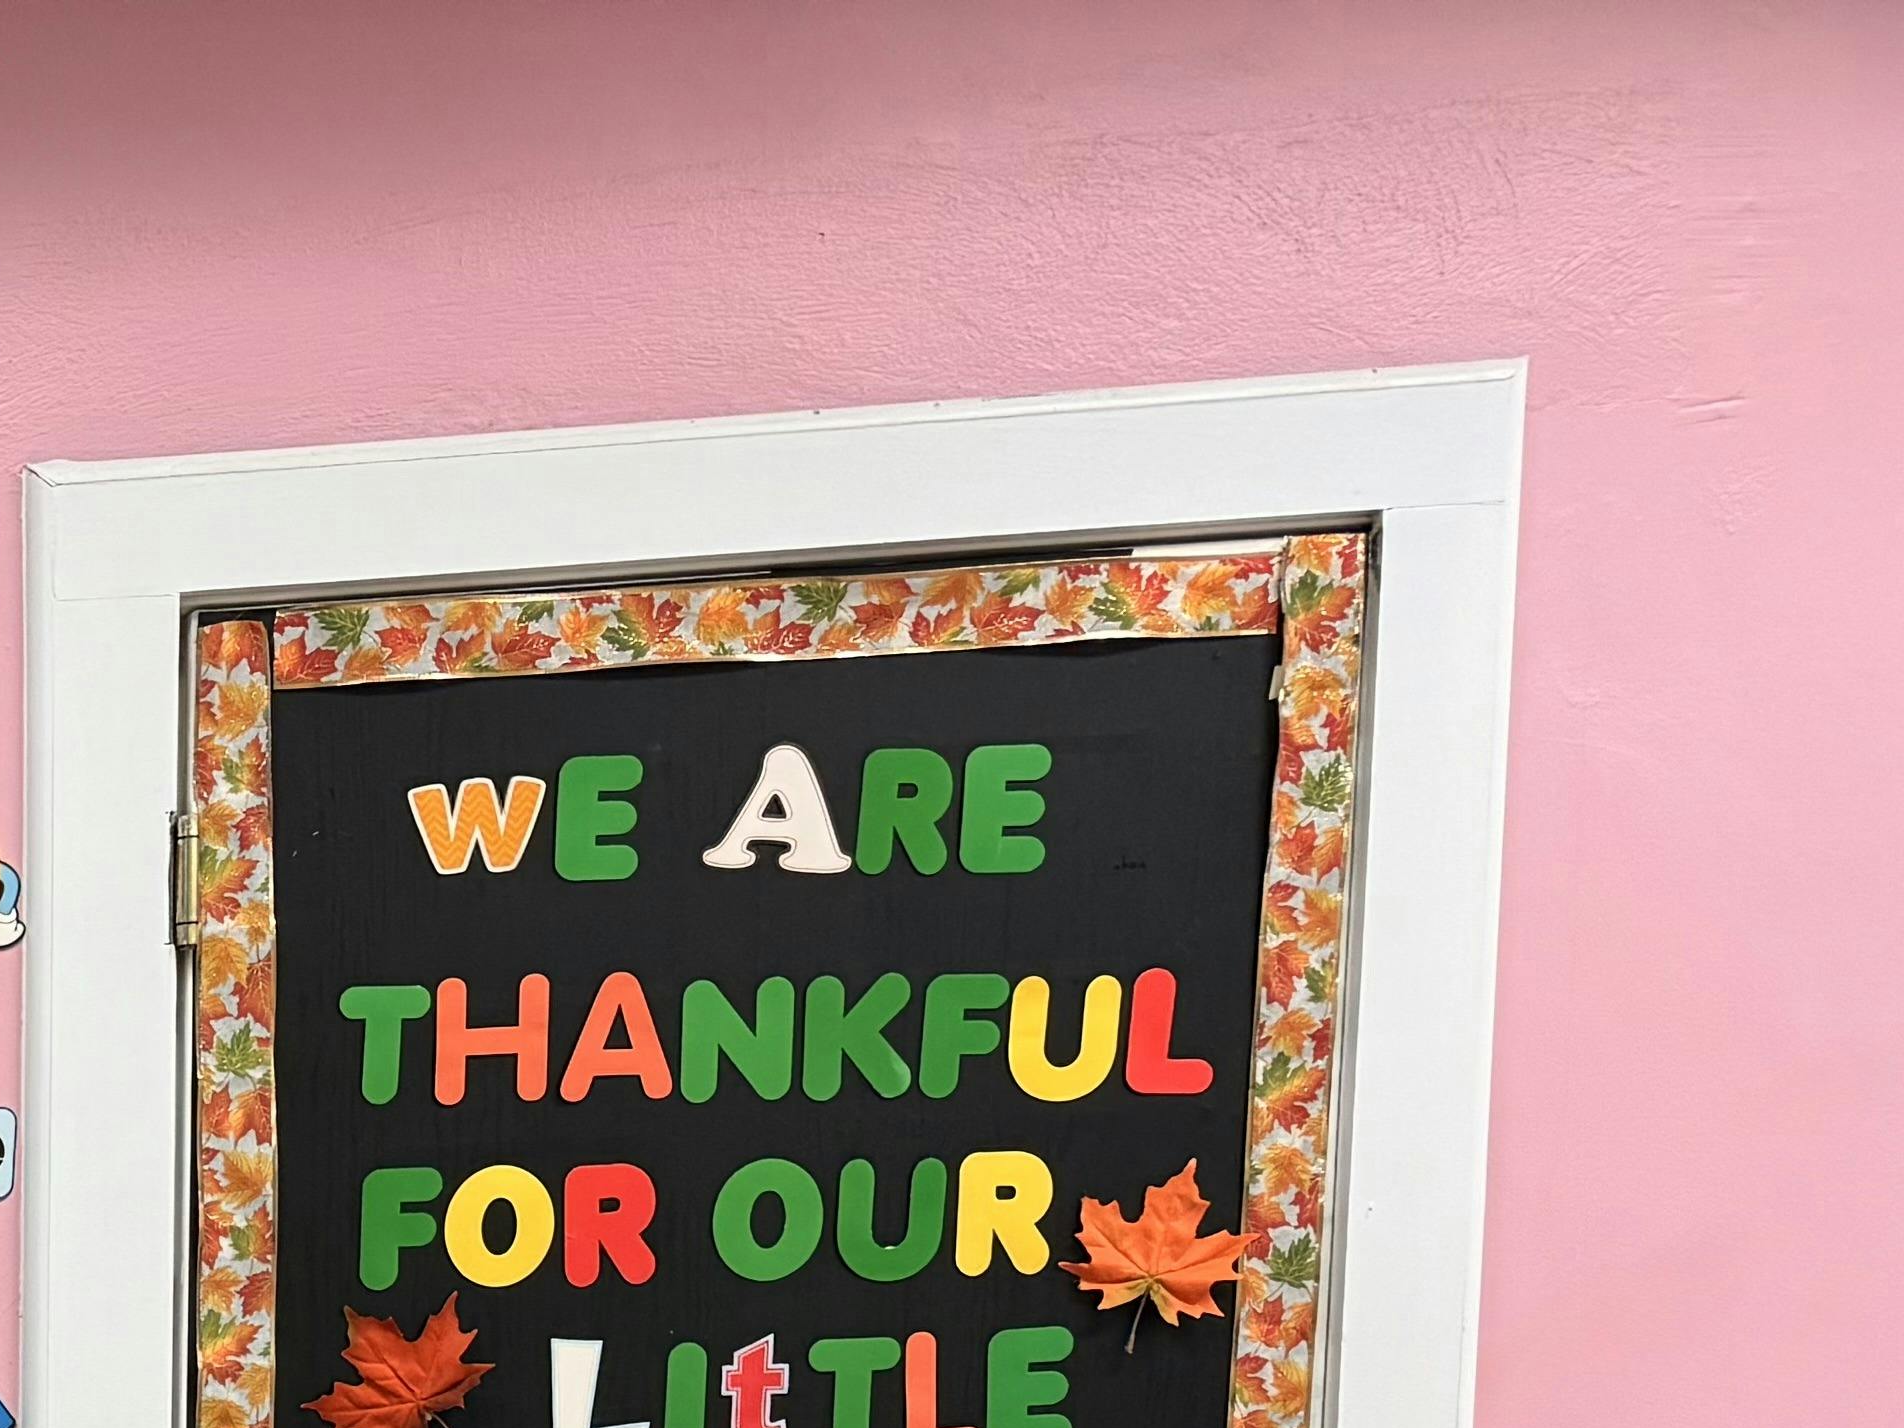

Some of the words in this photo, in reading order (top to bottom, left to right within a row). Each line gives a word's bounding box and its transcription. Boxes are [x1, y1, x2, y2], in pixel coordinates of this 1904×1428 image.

[701, 743, 1053, 876] ARE
[339, 966, 1214, 1106] THANKFUL
[359, 1163, 657, 1291] FOR
[711, 1150, 1053, 1282] OUR
